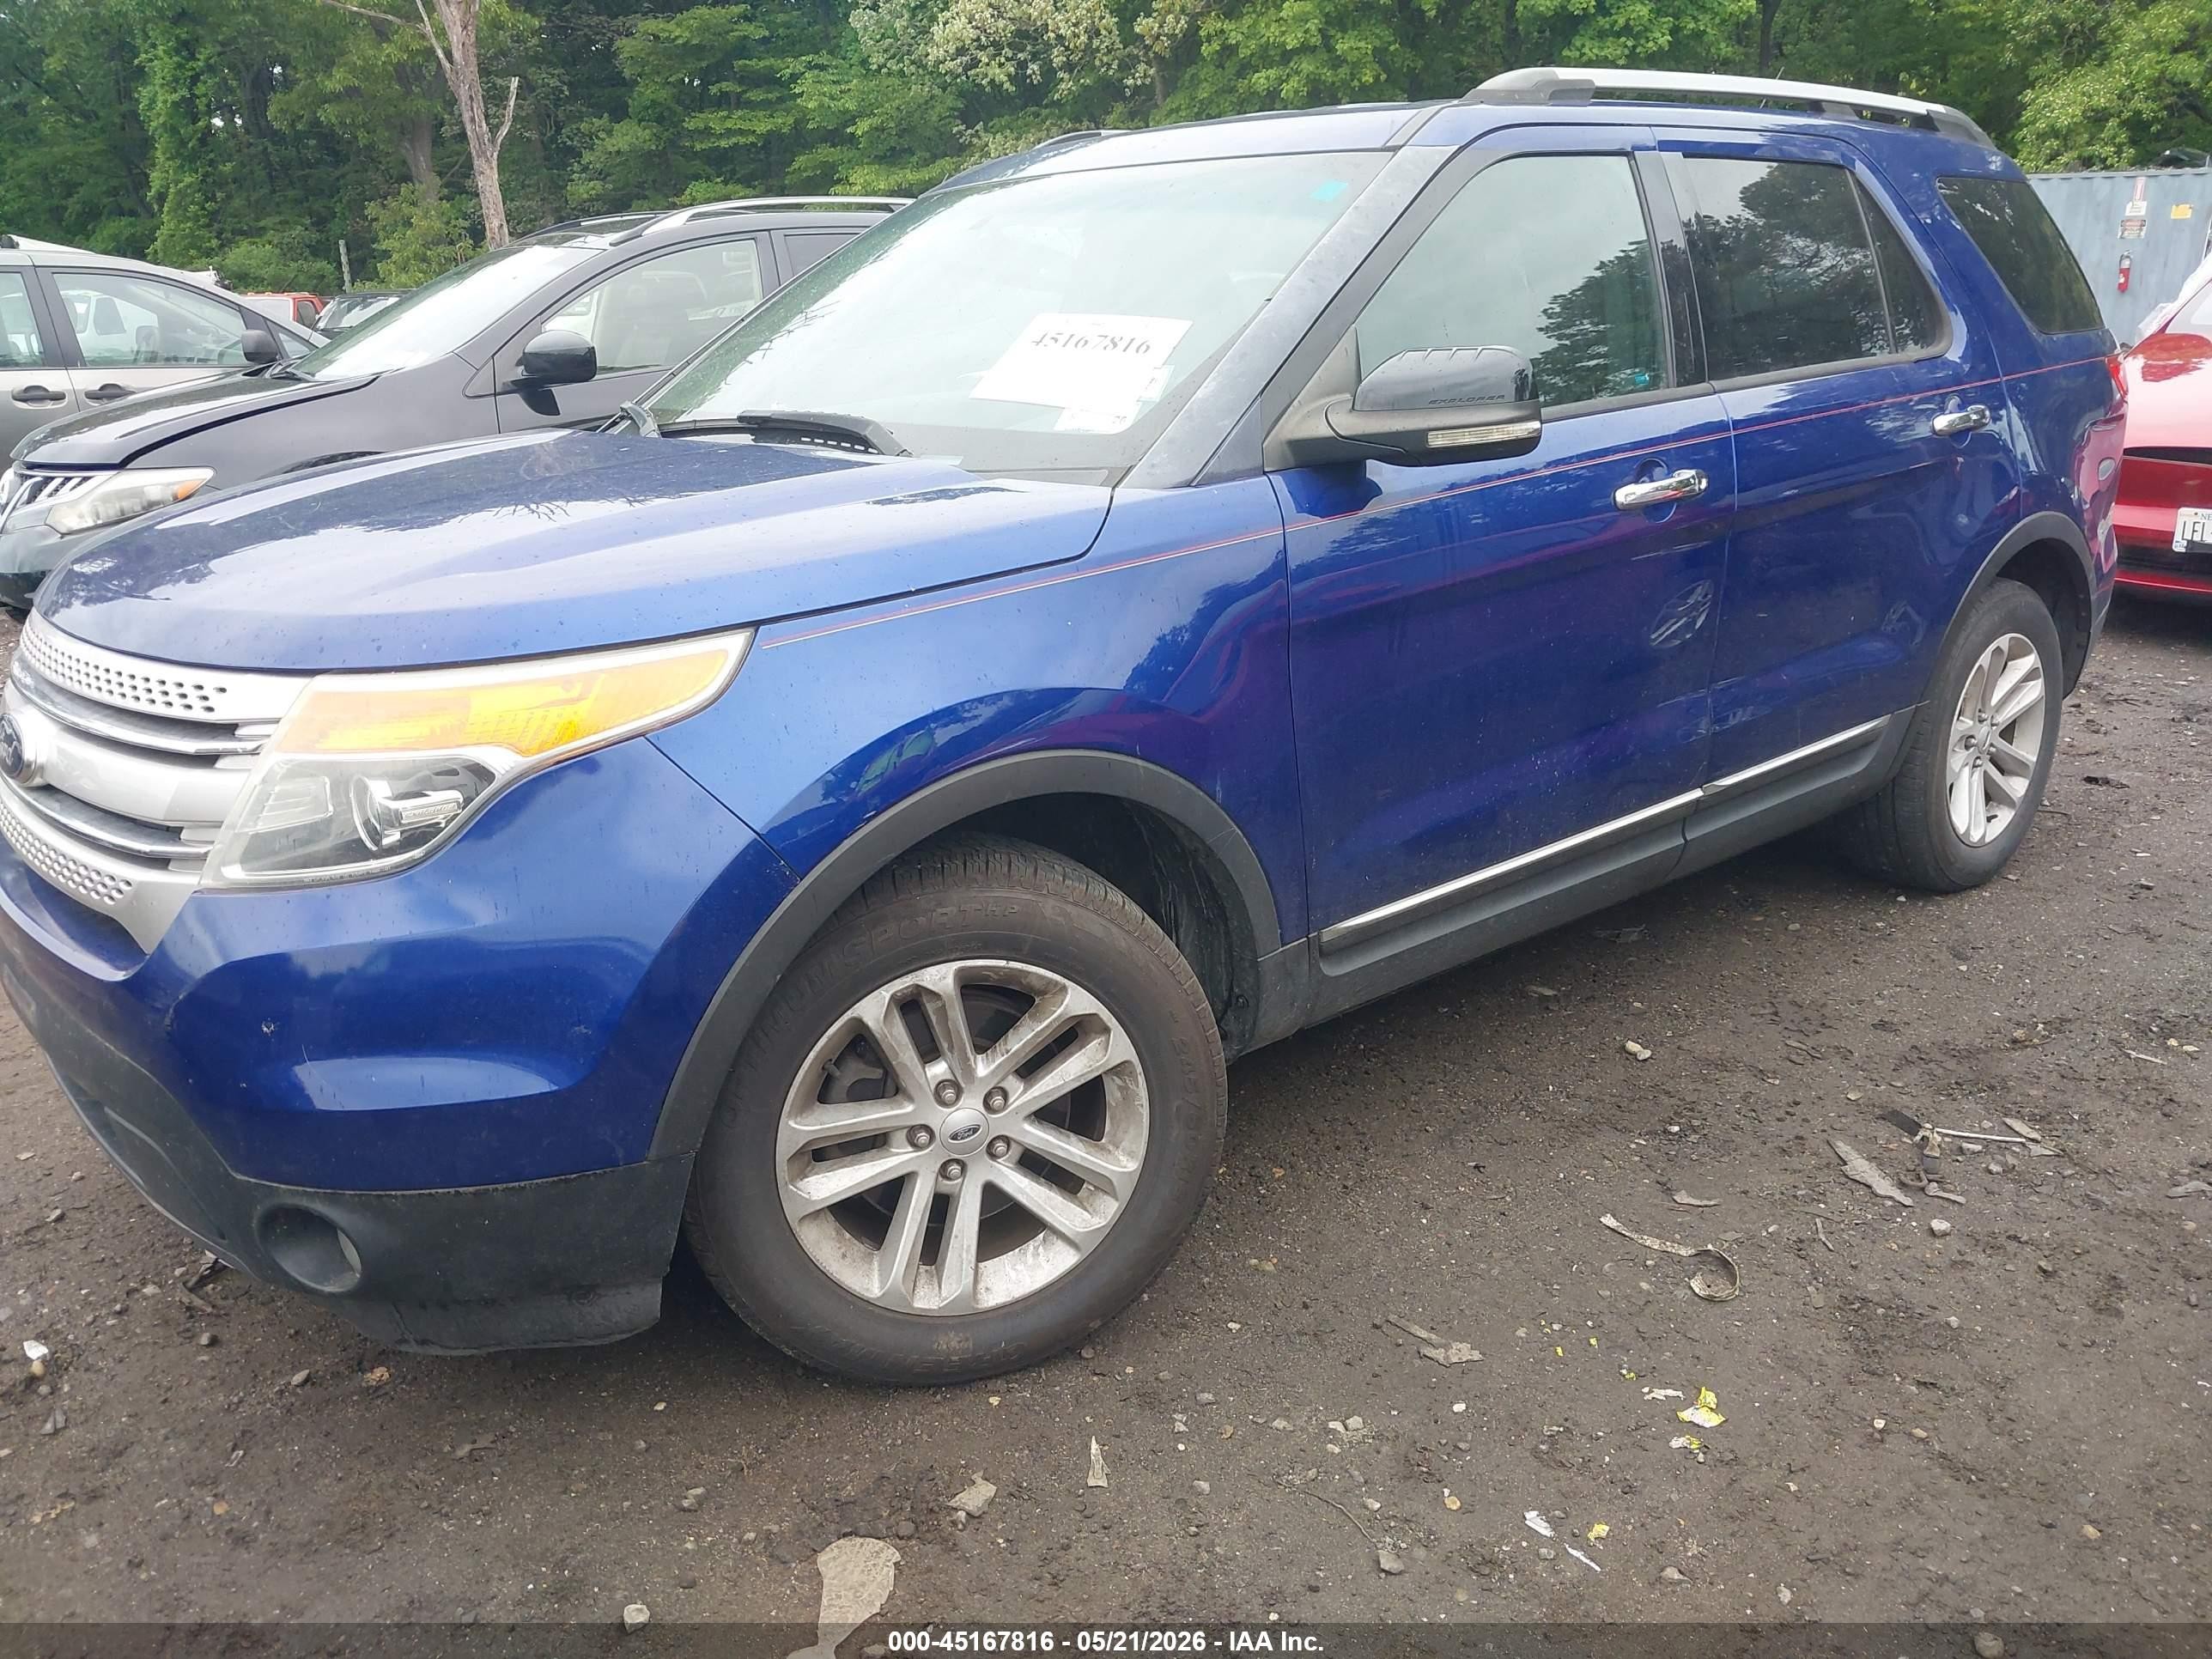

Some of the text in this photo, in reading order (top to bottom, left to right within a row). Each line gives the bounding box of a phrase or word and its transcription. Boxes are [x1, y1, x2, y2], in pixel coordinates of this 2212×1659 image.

[1030, 331, 1152, 355] 45167816
[1429, 395, 1505, 405] EXPLORER
[956, 1127, 974, 1140] Ford
